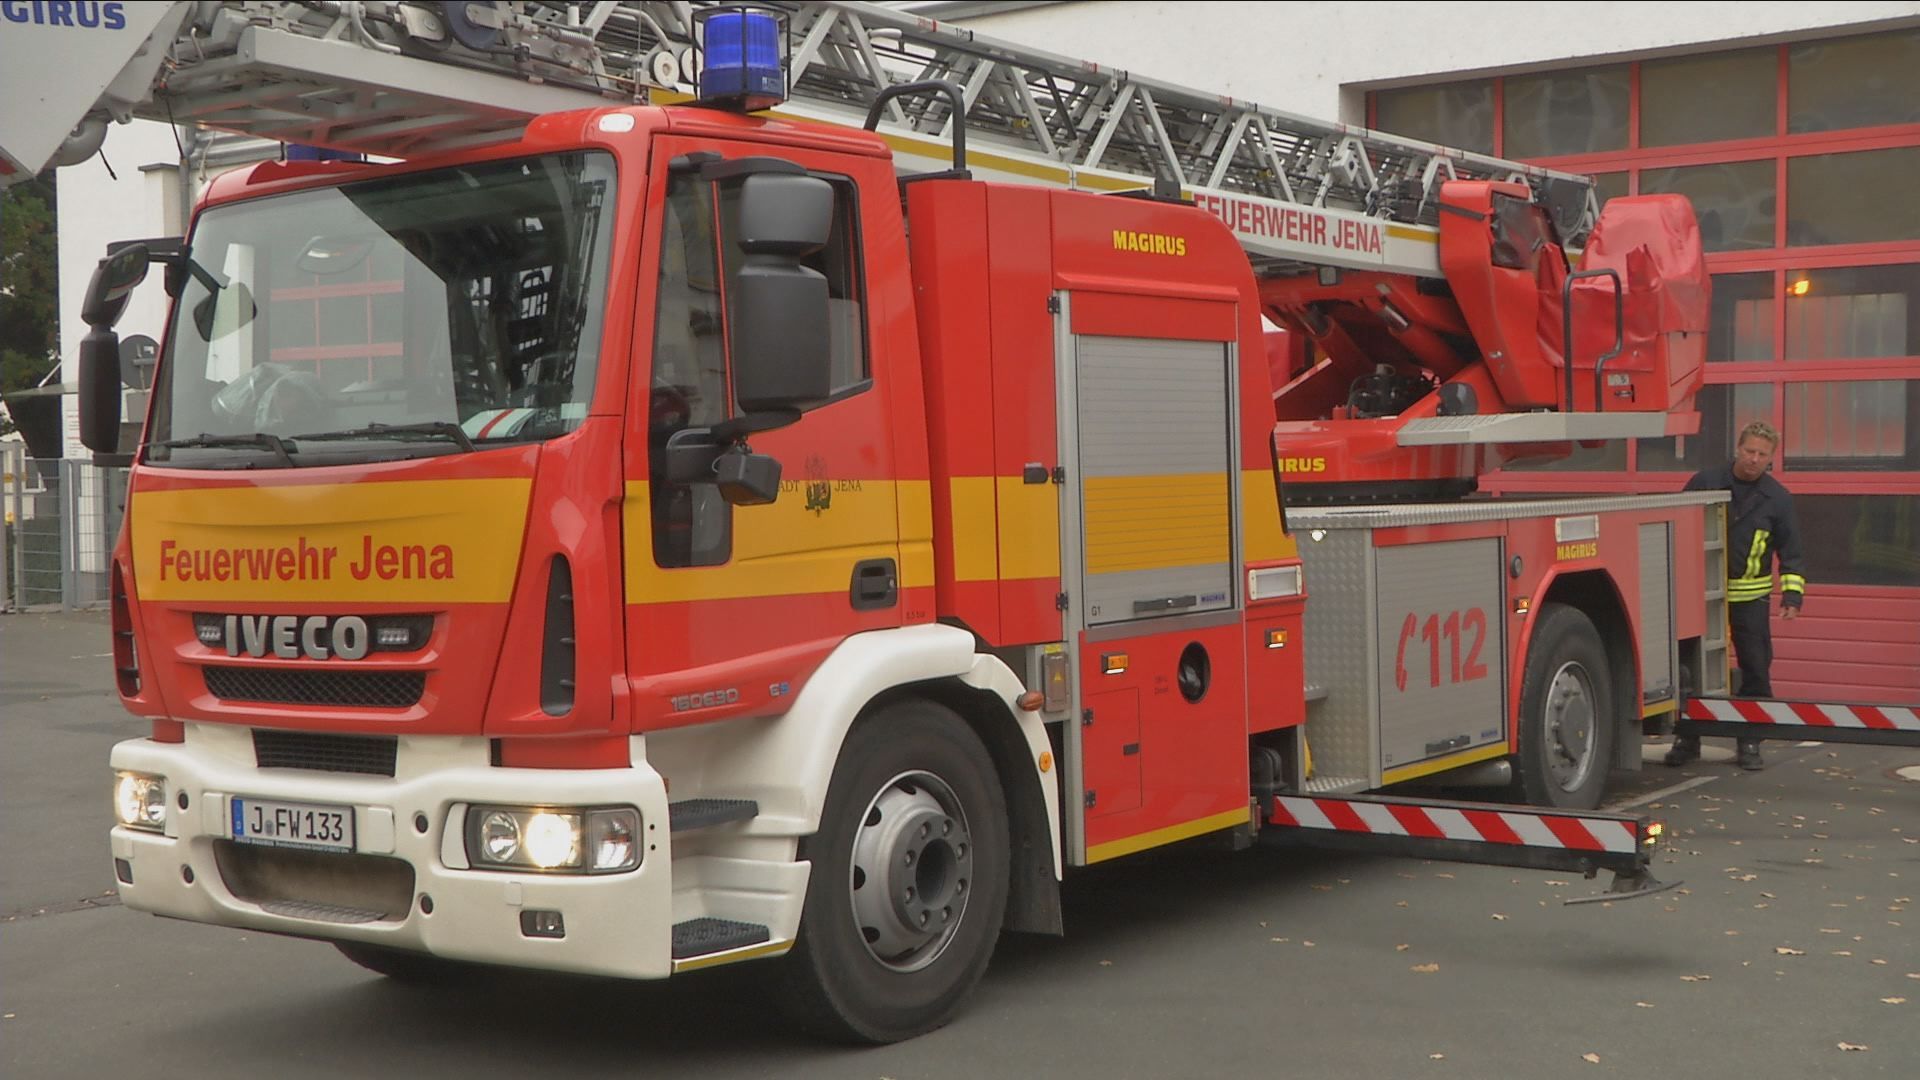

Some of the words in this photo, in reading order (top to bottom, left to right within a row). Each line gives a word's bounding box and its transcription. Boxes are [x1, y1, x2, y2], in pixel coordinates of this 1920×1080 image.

[1113, 230, 1186, 256] MAGIRUS
[1332, 218, 1382, 255] JENA
[834, 479, 862, 492] JENA
[160, 537, 338, 582] Feuerwehr
[350, 535, 455, 581] Jena
[1556, 543, 1597, 561] MAGIRUS
[225, 615, 369, 661] IVECO
[1422, 607, 1488, 689] 112
[251, 806, 263, 834] J
